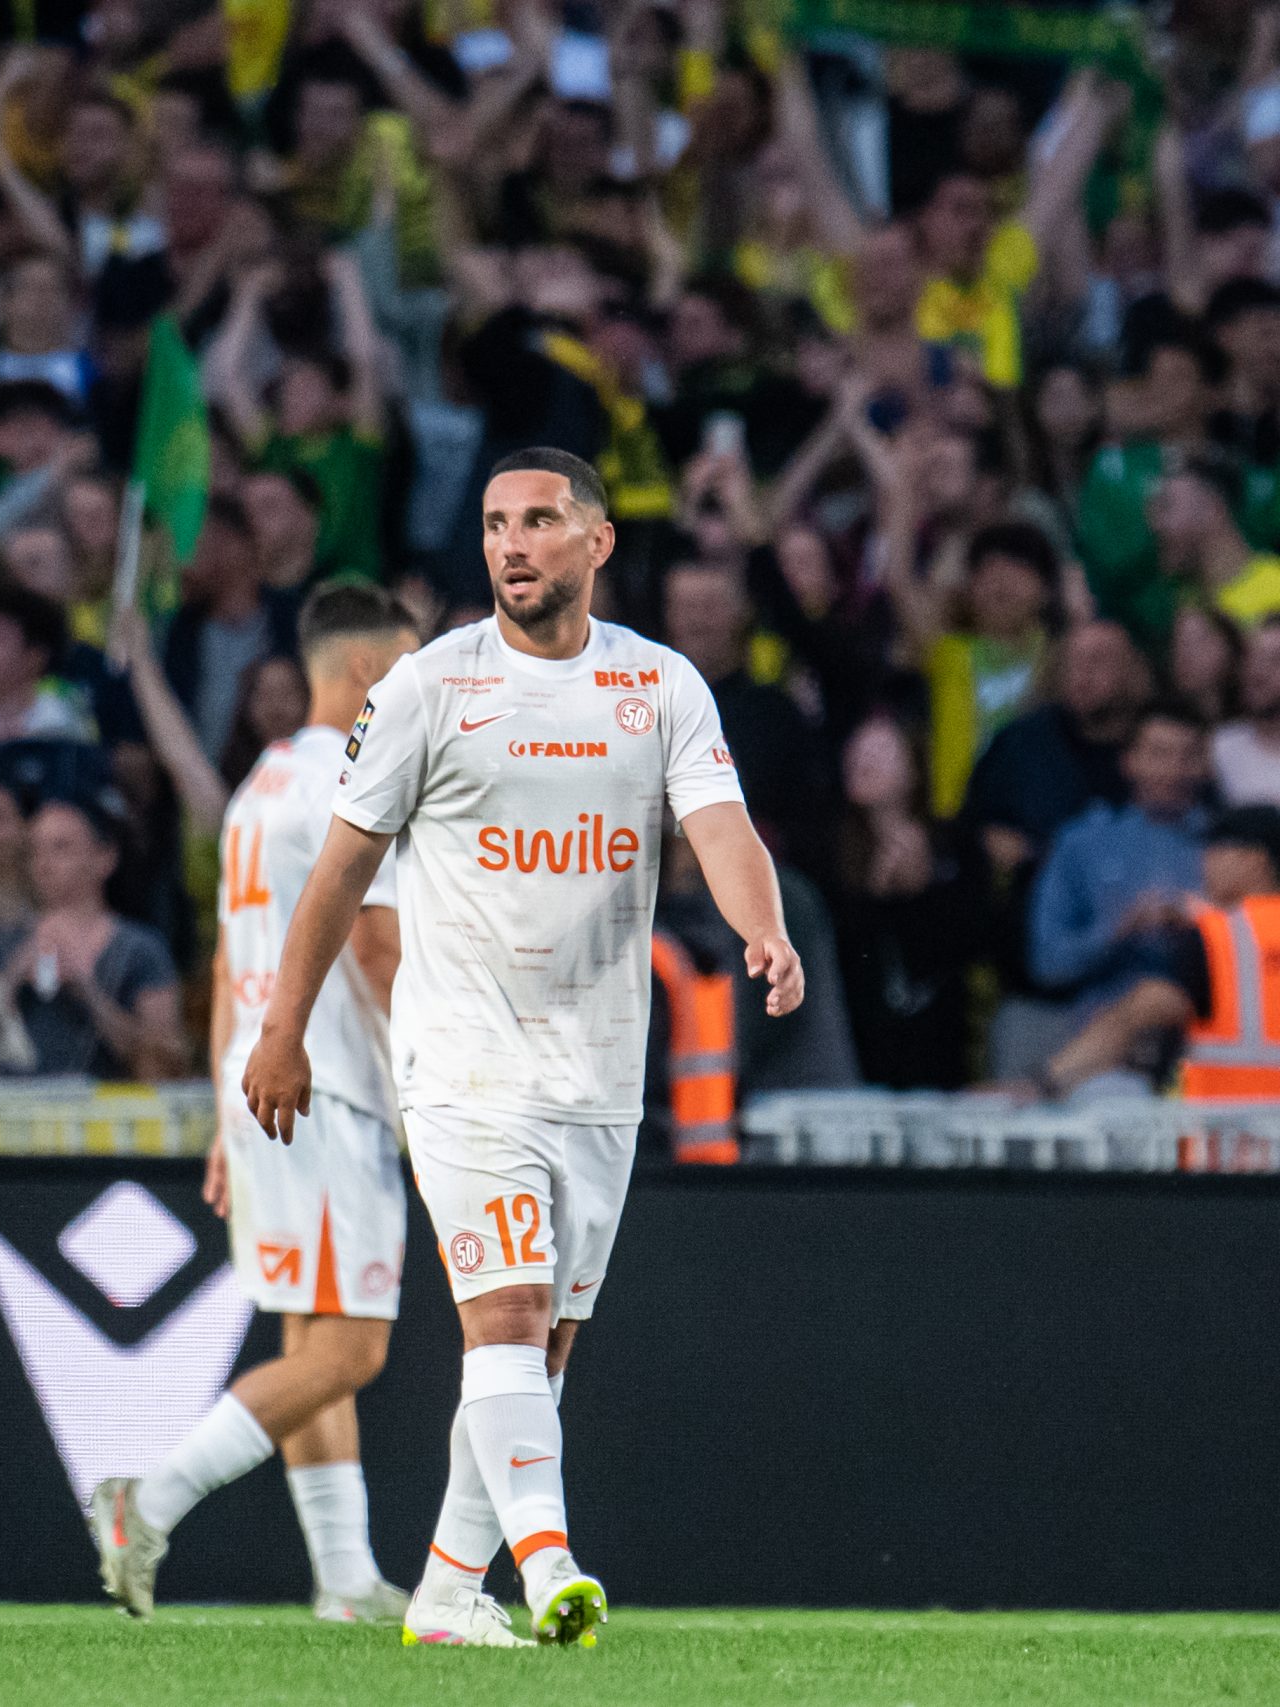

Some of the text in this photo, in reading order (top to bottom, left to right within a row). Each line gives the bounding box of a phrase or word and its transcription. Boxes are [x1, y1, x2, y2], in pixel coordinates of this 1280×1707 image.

[594, 668, 660, 688] BIG M
[529, 742, 608, 758] FAUN
[477, 812, 640, 875] swile
[484, 1193, 547, 1267] 12
